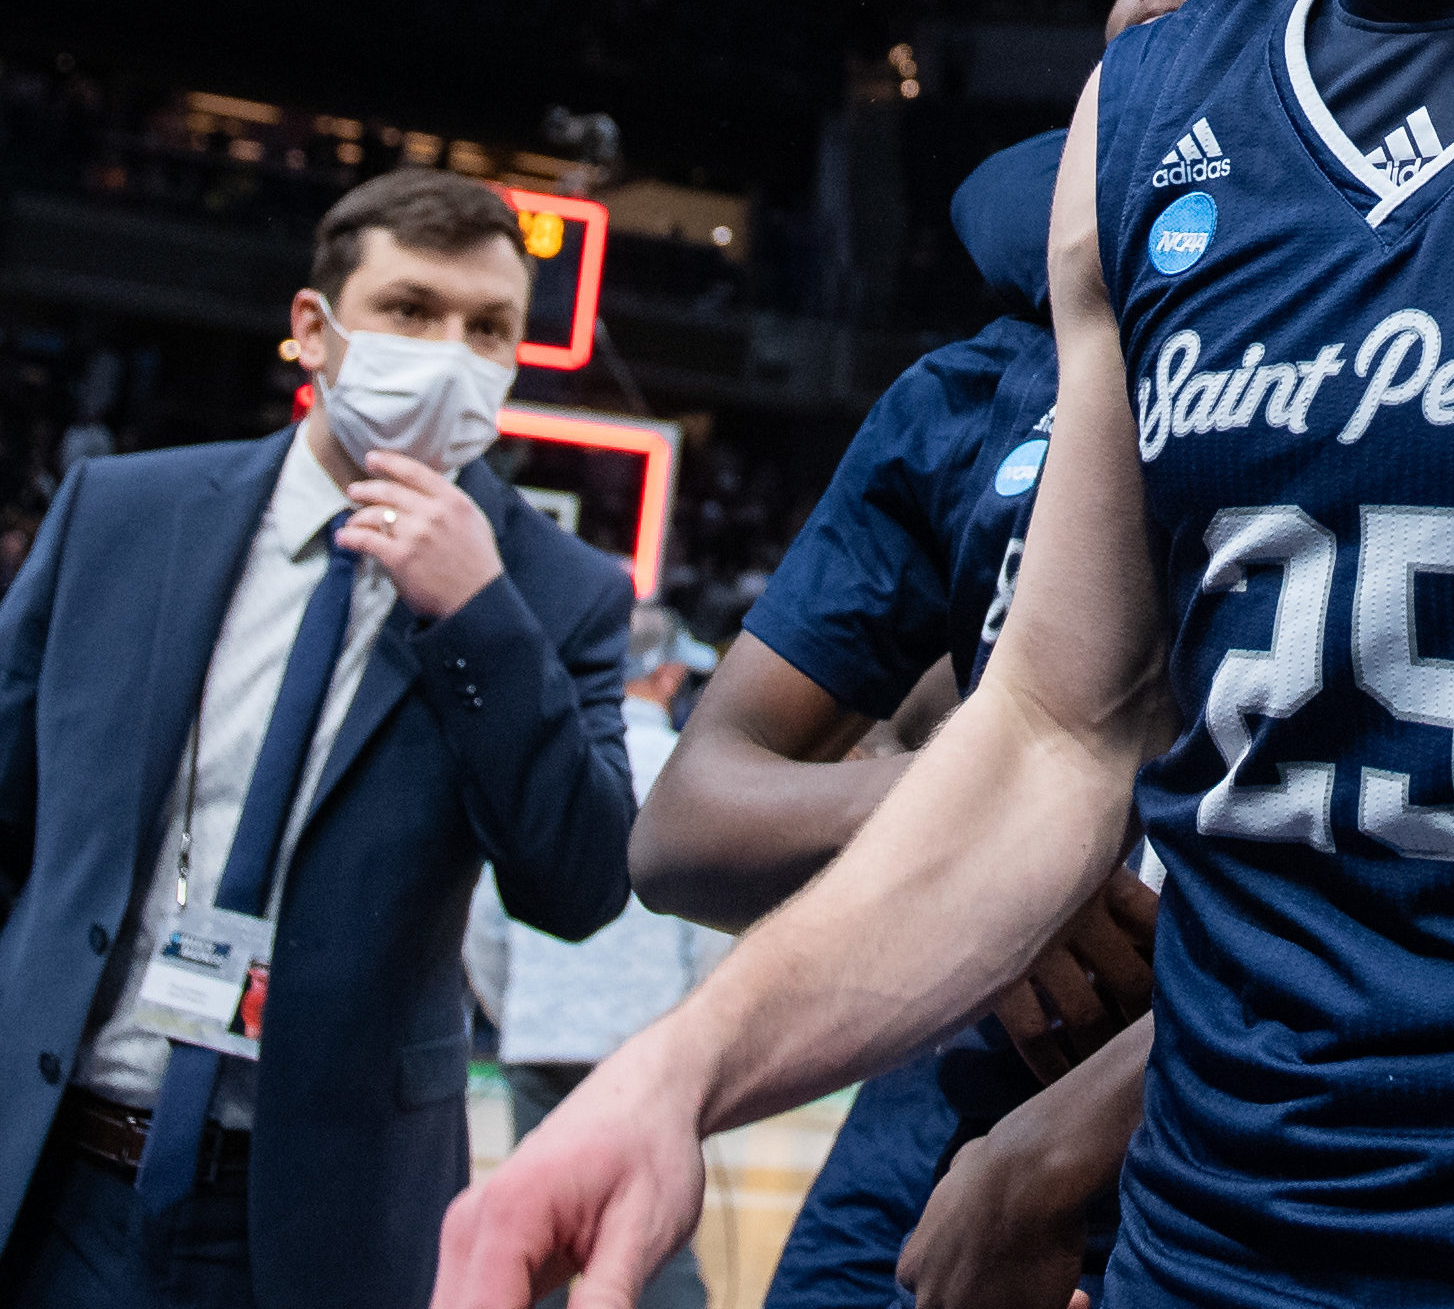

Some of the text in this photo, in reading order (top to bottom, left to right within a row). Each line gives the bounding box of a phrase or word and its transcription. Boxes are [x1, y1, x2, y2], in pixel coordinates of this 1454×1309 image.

[1152, 158, 1231, 188] adidas
[1156, 230, 1209, 253] NCAA
[1138, 329, 1345, 462] Saint
